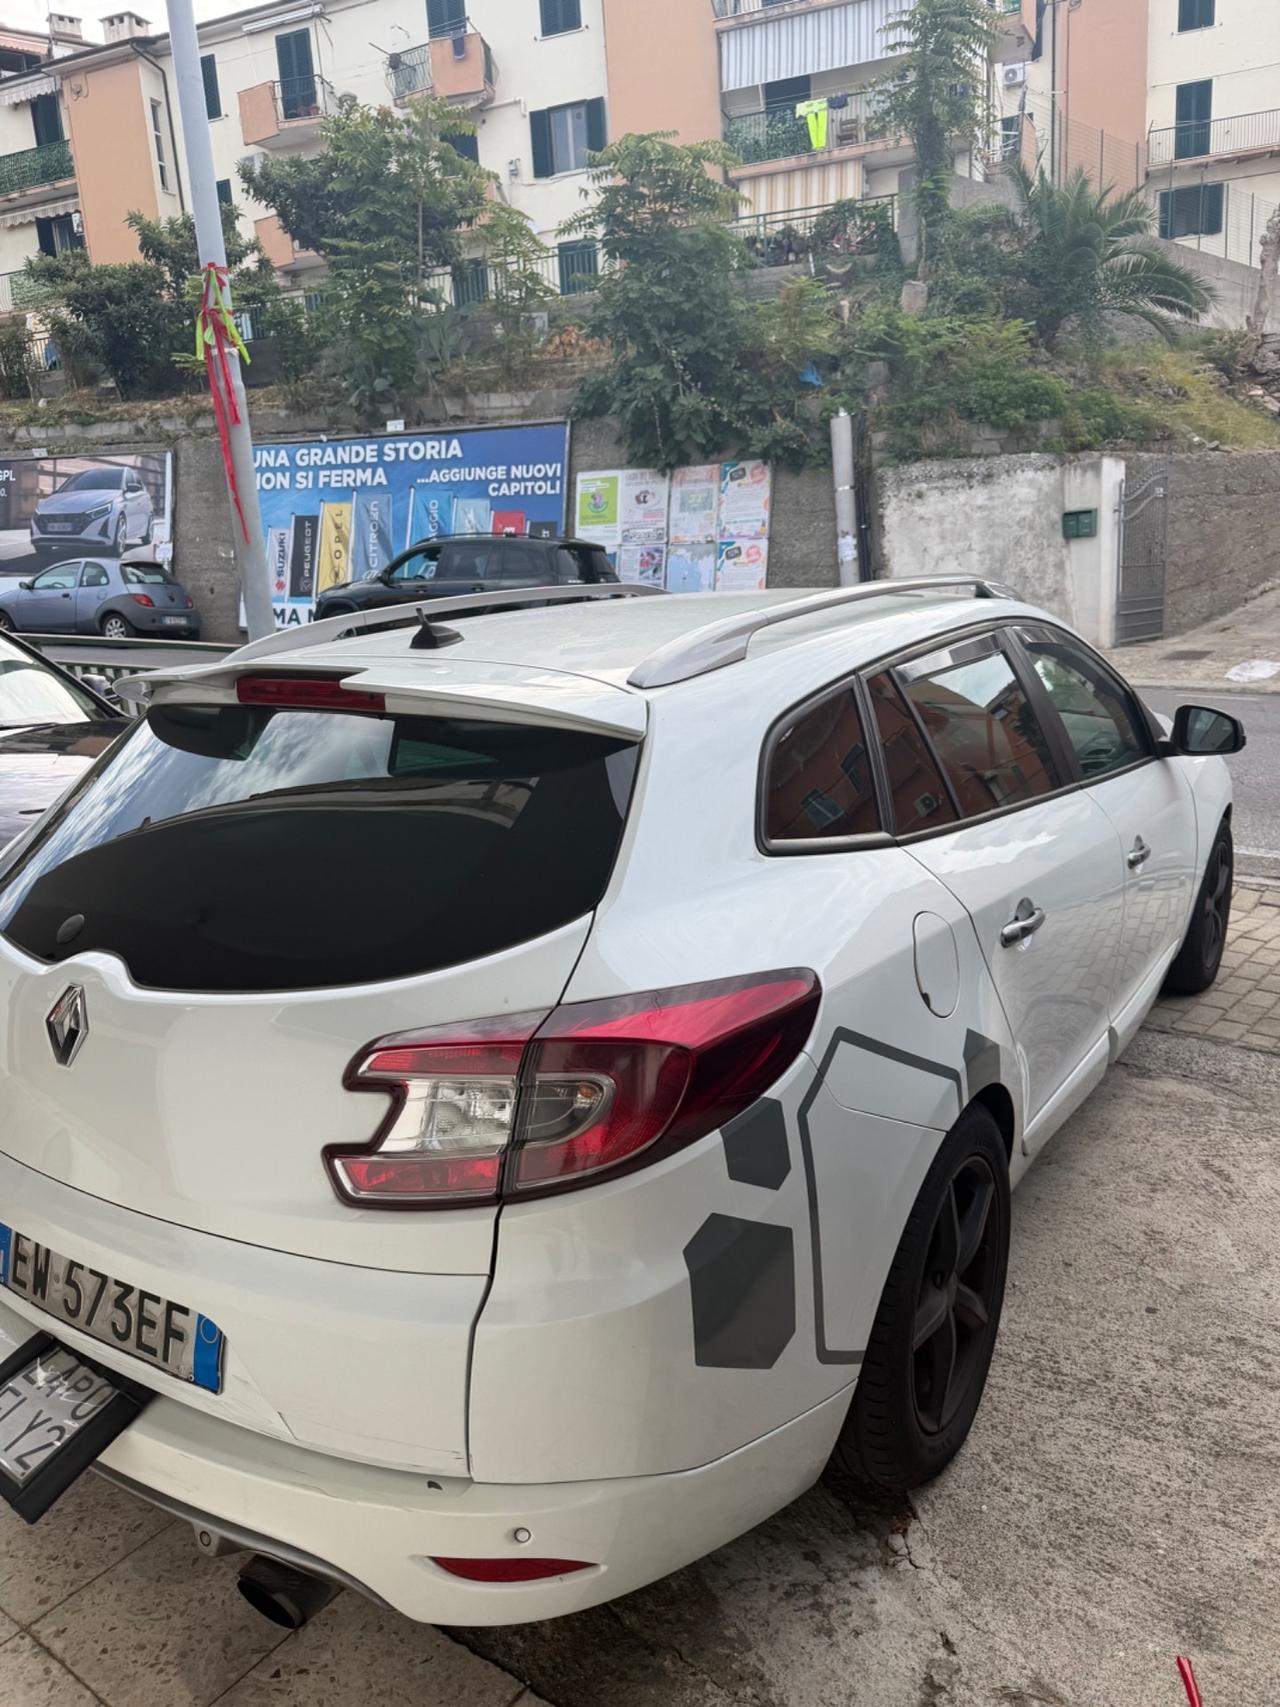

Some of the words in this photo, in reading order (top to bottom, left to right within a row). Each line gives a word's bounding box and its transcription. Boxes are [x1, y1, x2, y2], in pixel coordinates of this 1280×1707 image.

[295, 444, 378, 466] GRANDE
[383, 439, 463, 462] STORIA
[295, 471, 313, 489] SI
[319, 467, 388, 488] FERMA
[416, 466, 507, 484] ...AGGIUNGE
[511, 464, 561, 479] NUOVI
[488, 480, 561, 497] CAPITOLI
[334, 510, 343, 560] OPEL
[277, 532, 286, 577] SUZUKI
[303, 521, 312, 577] PEUGEOT
